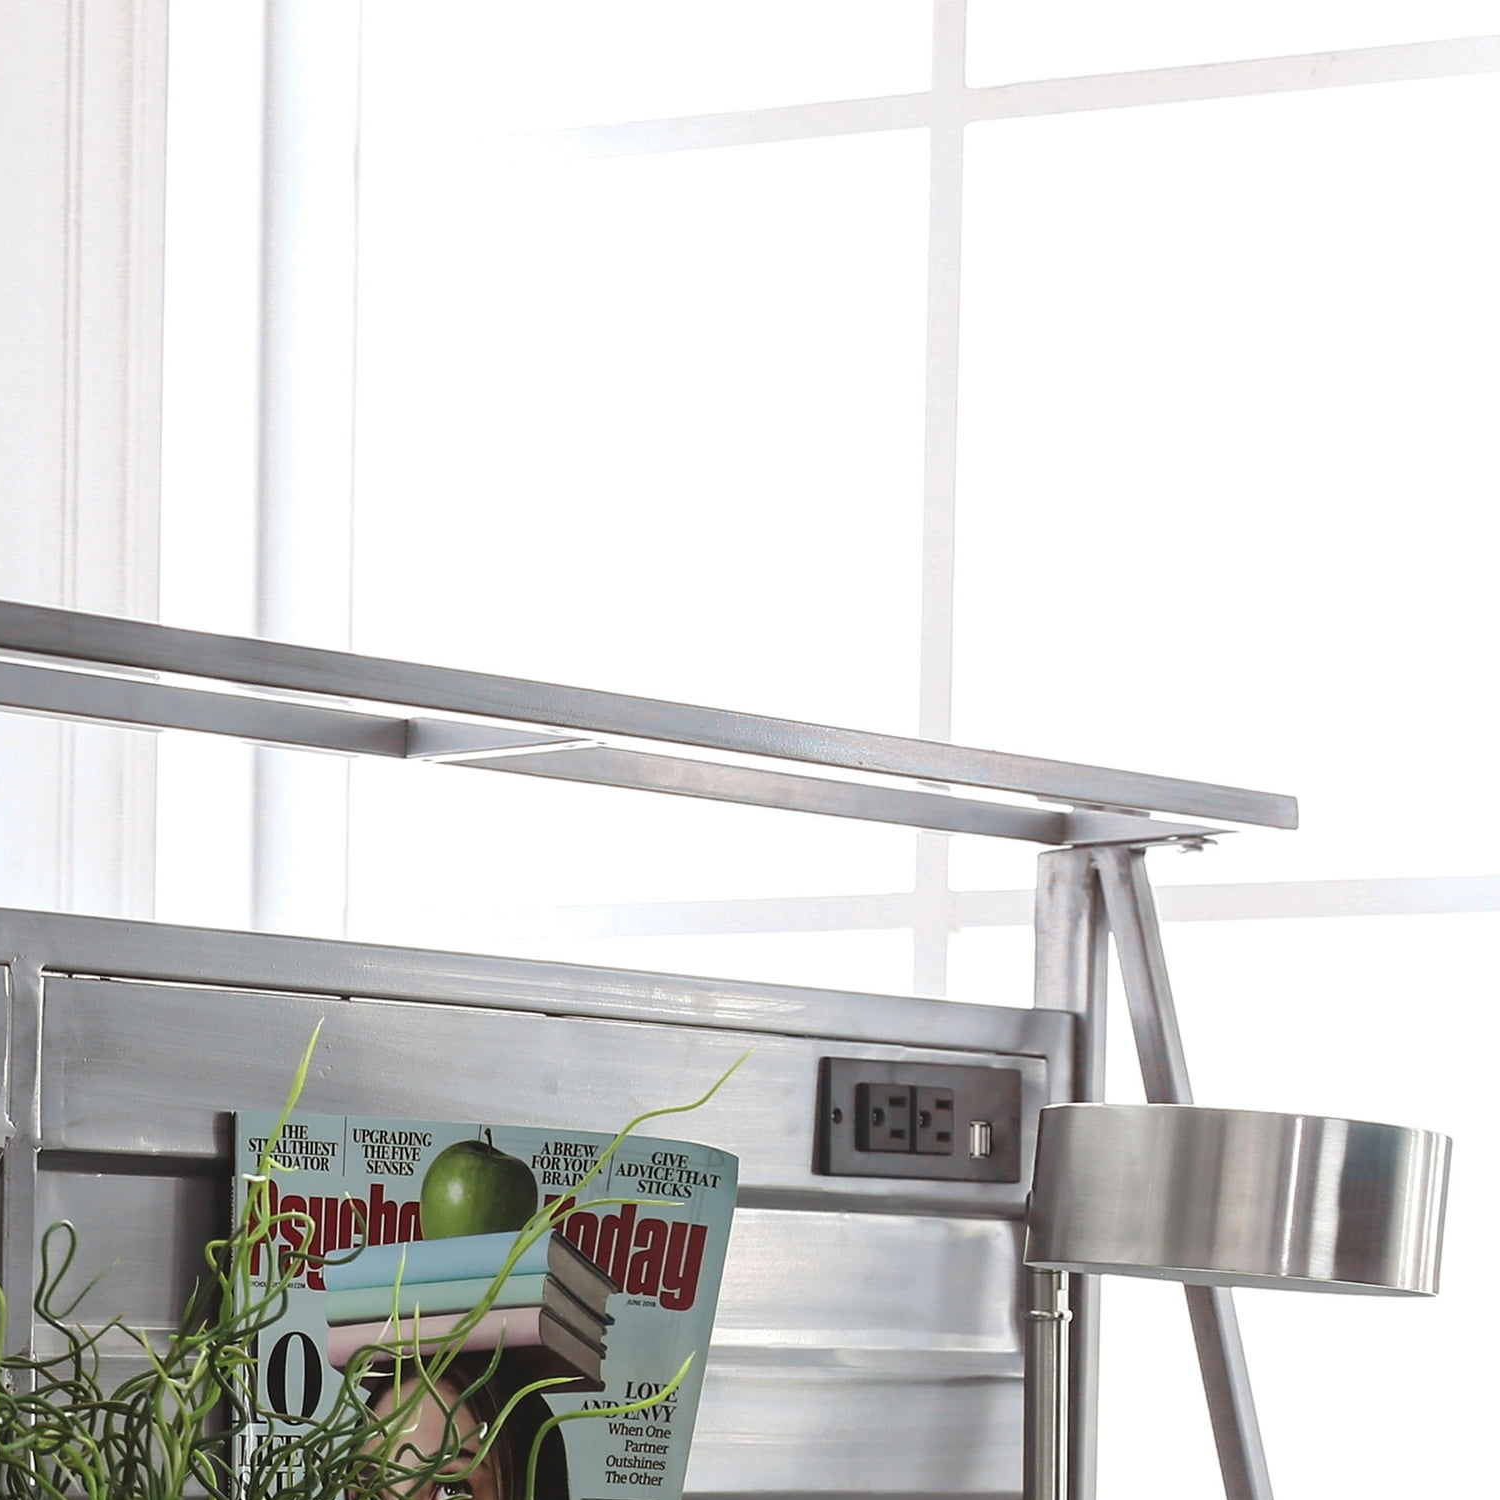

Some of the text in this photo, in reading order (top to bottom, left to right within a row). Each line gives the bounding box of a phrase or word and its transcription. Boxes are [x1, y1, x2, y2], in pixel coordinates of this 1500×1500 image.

[282, 1124, 308, 1139] THE
[353, 1128, 432, 1147] UPGRADING
[362, 1144, 421, 1161] THE FIVE
[541, 1141, 599, 1157] A BREW
[256, 1154, 330, 1171] PEDATOR
[366, 1160, 414, 1176] SENSES
[531, 1155, 561, 1170] FOR
[652, 1151, 689, 1169] GIVE
[542, 1171, 587, 1187] BRAIN
[615, 1163, 722, 1189] ADVICE THAT
[636, 1180, 692, 1199] STICKS
[248, 1178, 425, 1291] Psycho
[625, 1381, 679, 1404] LOVE
[623, 1402, 677, 1423] ENVY
[608, 1422, 672, 1439] When One
[239, 1434, 303, 1467] LIFE
[624, 1440, 669, 1455] Partner
[606, 1455, 666, 1471] Outshines
[605, 1471, 664, 1486] The Other
